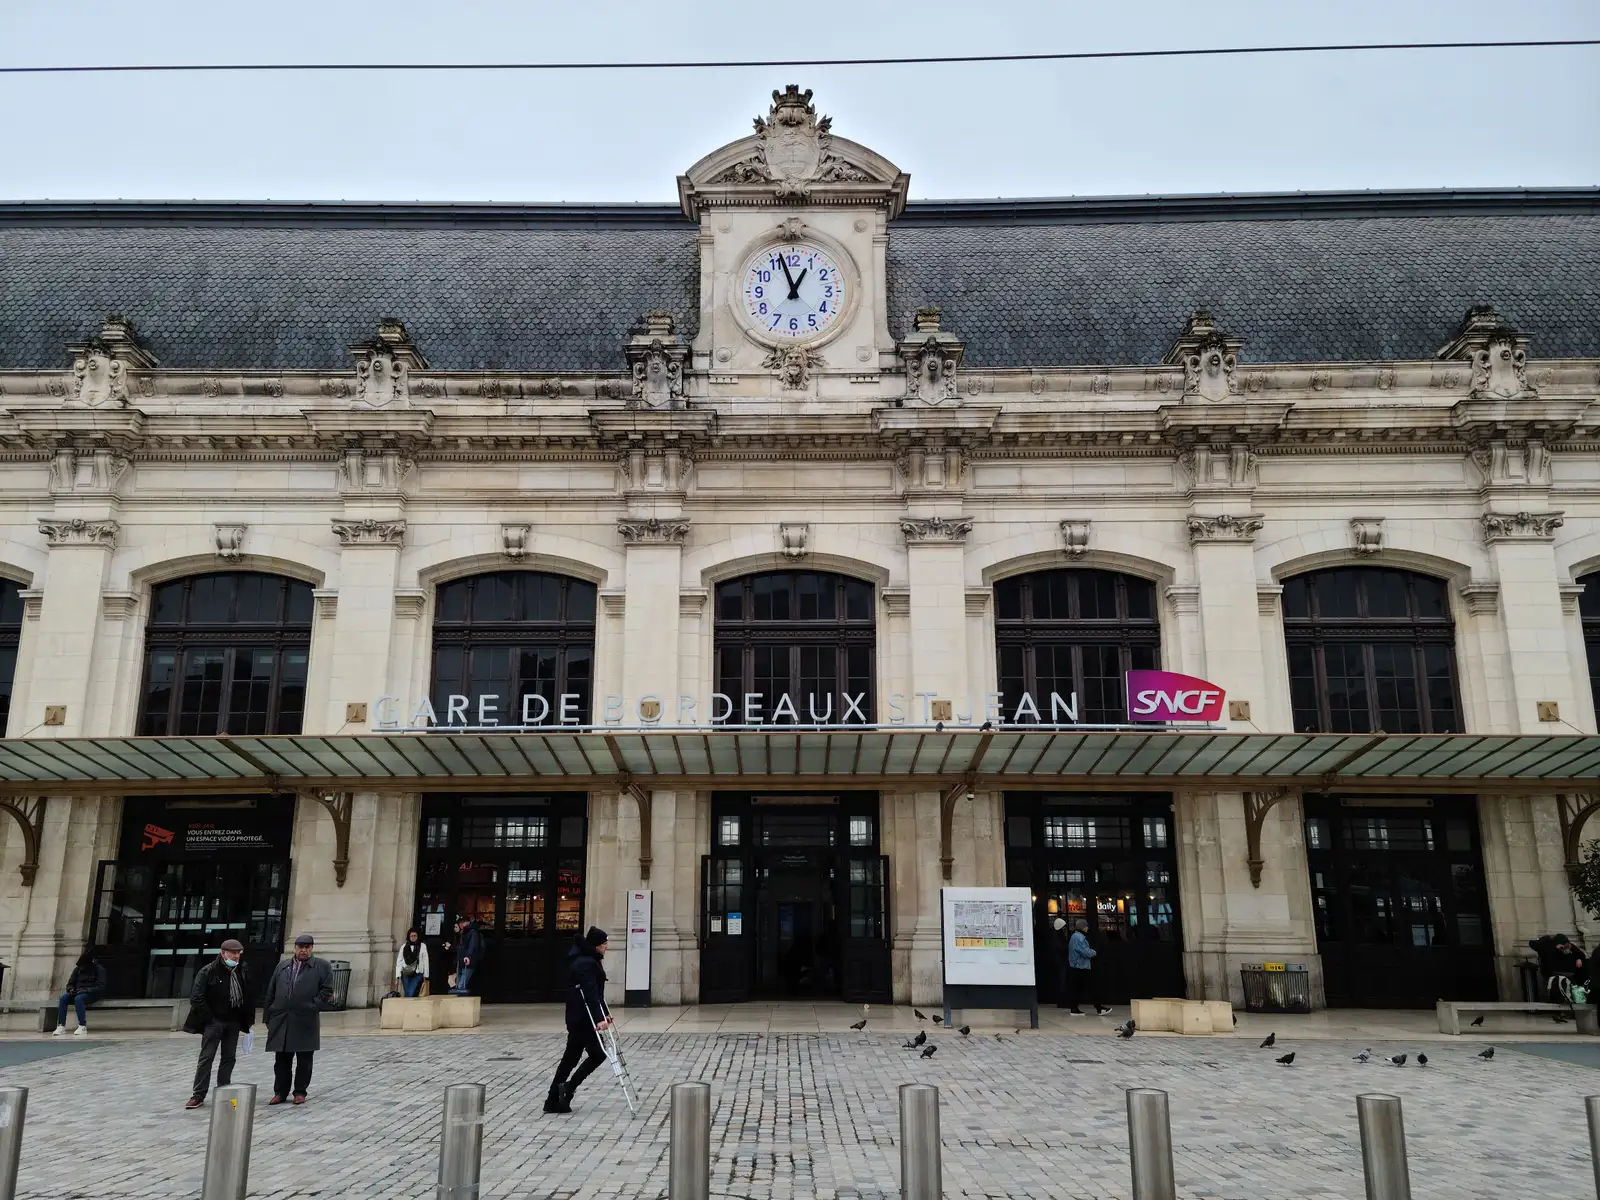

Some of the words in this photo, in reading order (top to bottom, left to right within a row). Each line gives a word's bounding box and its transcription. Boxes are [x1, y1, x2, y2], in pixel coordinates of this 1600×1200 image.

[770, 258, 782, 270] 11
[786, 255, 800, 267] 12
[808, 258, 813, 270] 1
[757, 270, 771, 282] 10
[819, 268, 828, 280] 2
[754, 286, 764, 298] 9
[824, 286, 832, 298] 3
[758, 302, 768, 314] 8
[819, 300, 828, 314] 4
[772, 314, 782, 326] 7
[789, 318, 798, 330] 6
[808, 314, 816, 326] 5
[373, 693, 499, 724] GARE
[522, 692, 580, 723] DE
[603, 692, 866, 723] BORDEAUX
[888, 691, 937, 724] ST
[957, 691, 1078, 723] JEAN
[1133, 689, 1220, 715] SNCF
[1097, 902, 1116, 912] daily
